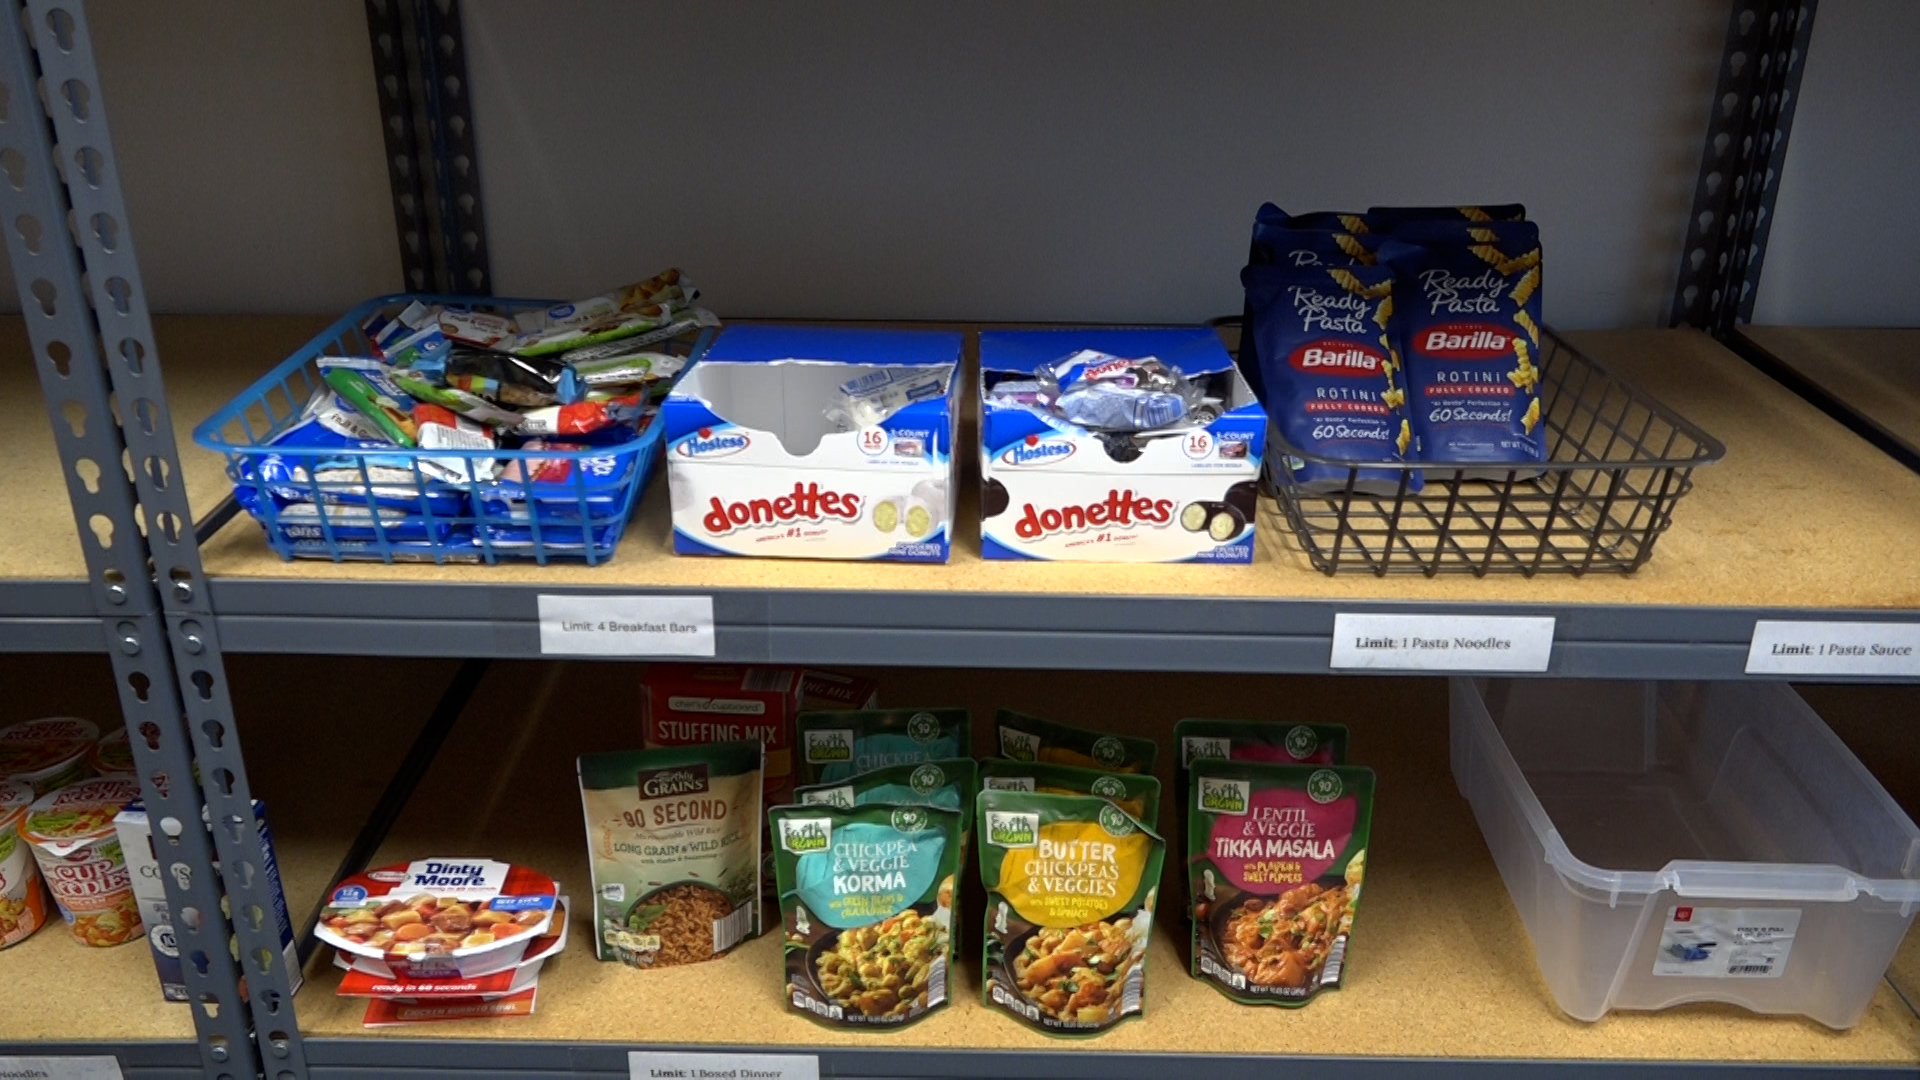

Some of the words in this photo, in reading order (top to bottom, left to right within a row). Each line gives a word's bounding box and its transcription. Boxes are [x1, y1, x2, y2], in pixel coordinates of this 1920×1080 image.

[1418, 269, 1509, 298] Ready
[1288, 285, 1372, 320] Ready
[1427, 289, 1500, 315] Pasta
[1298, 306, 1367, 334] Pasta
[1425, 331, 1506, 351] Barilla
[1303, 348, 1378, 370] Barilla
[1437, 371, 1501, 383] ROTINI
[1316, 387, 1377, 402] ROTINI
[1468, 386, 1509, 394] COOKED
[1347, 404, 1386, 413] COOKED
[1429, 408, 1451, 422] 60
[1453, 407, 1513, 422] Seconds!
[864, 432, 882, 444] 16
[1312, 425, 1334, 440] 60
[1335, 425, 1390, 440] Seconds!
[687, 433, 745, 456] Hostess
[1190, 436, 1207, 448] 16
[1013, 444, 1070, 465] Hostess
[703, 482, 859, 532] donettes
[1015, 489, 1173, 539] donettes
[786, 527, 801, 538] #1
[1096, 533, 1112, 542] #1
[597, 622, 605, 631] 4
[608, 621, 666, 633] Breakfast
[669, 623, 697, 633] Bars
[1355, 637, 1398, 649] Limit:
[1402, 637, 1408, 648] 1
[1412, 637, 1449, 649] Pasta
[1453, 637, 1512, 650] Noodles
[1771, 643, 1815, 656] Limit:
[1818, 644, 1825, 656] 1
[1828, 643, 1866, 656] Pasta
[1869, 643, 1912, 656] Sauce
[827, 686, 854, 700] MIX
[658, 721, 739, 742] STUFFING
[745, 724, 777, 744] MIX
[918, 723, 930, 733] 90
[809, 733, 849, 748] Earth
[857, 752, 931, 768] CHICKPEA
[920, 774, 934, 785] 90
[1318, 781, 1331, 792] 90
[643, 779, 704, 797] GRAINS
[1103, 787, 1115, 797] 90
[1203, 782, 1243, 799] Earth
[623, 809, 645, 828] 90
[653, 799, 727, 826] SECOND
[903, 813, 917, 823] 90
[1110, 814, 1125, 825] 90
[1252, 808, 1309, 822] LENTIL
[784, 821, 826, 838] Earth
[992, 814, 1031, 833] Earth
[1243, 822, 1254, 836] &
[1257, 822, 1316, 838] VEGGIE
[614, 842, 642, 855] LONG
[644, 845, 679, 856] GRAIN
[689, 841, 718, 852] WILD
[834, 839, 918, 858] CHICKPEA
[1039, 839, 1116, 864] BUTTER
[1266, 840, 1335, 860] MASALA
[55, 860, 113, 881] CUP
[425, 862, 483, 876] Dinty
[833, 858, 844, 872] &
[847, 855, 909, 872] VEGGIE
[1024, 860, 1119, 880] CHICKPEAS
[414, 873, 485, 886] Moore
[833, 871, 907, 895] KORMA
[1028, 877, 1040, 893] &
[1042, 877, 1116, 898] VEGGIES
[372, 984, 403, 993] ready
[650, 1069, 687, 1078] Limit:
[690, 1069, 696, 1078] 1
[698, 1069, 737, 1078] Boxed
[740, 1069, 782, 1078] Dinner
